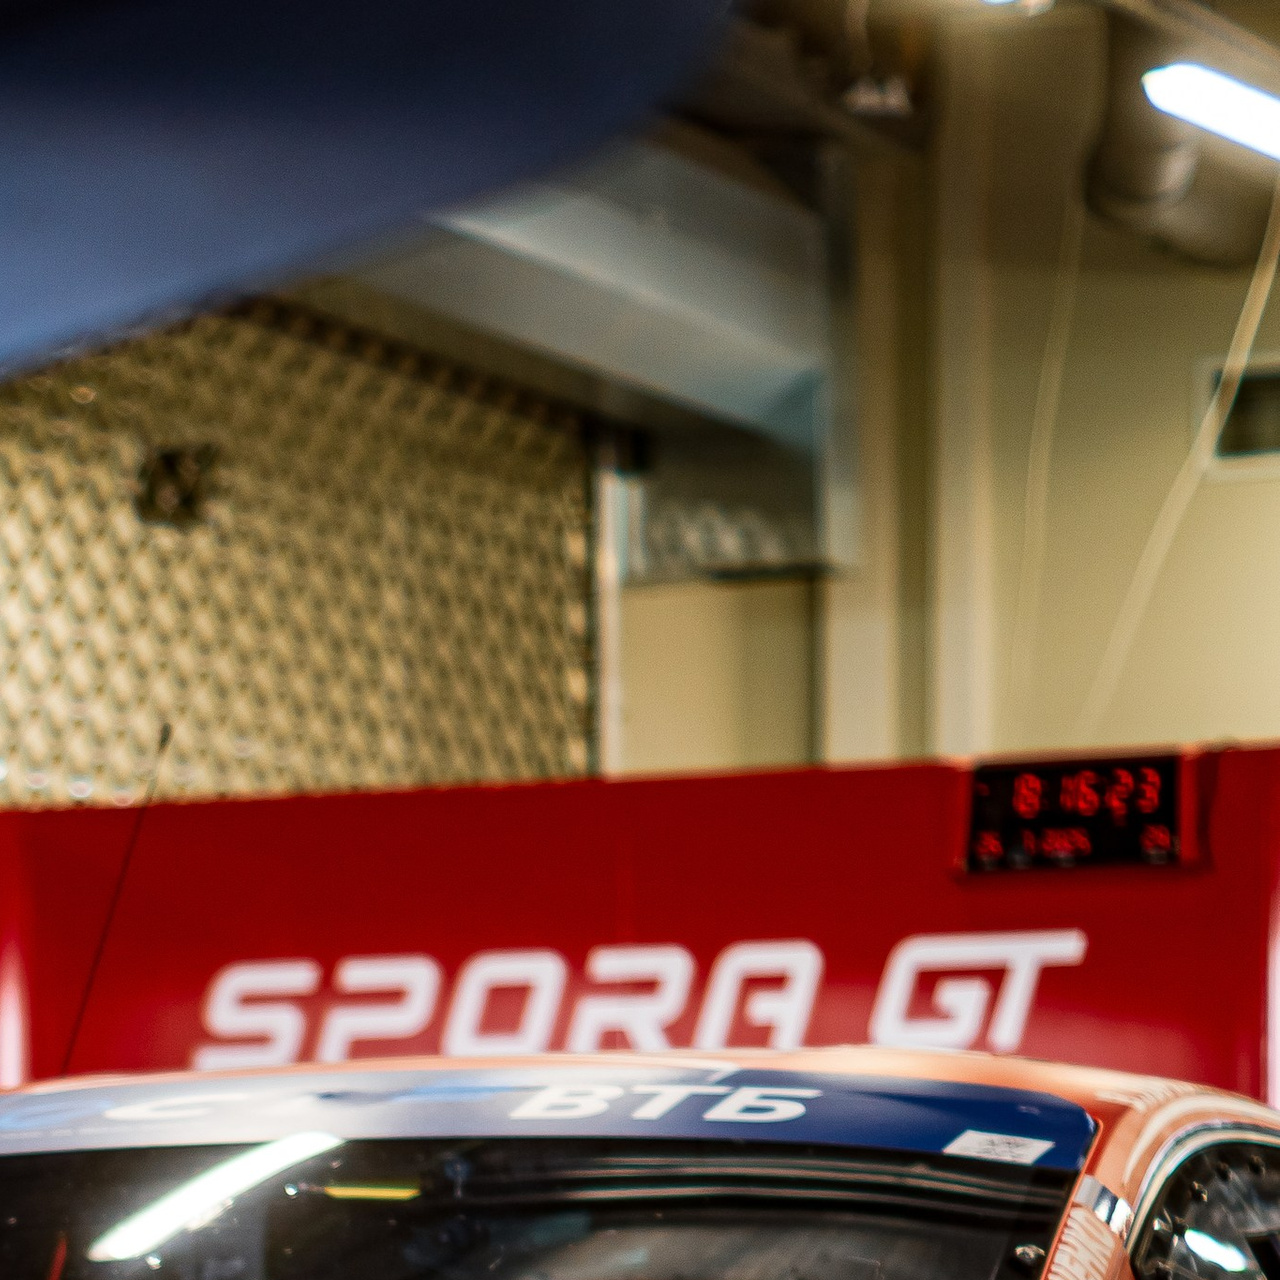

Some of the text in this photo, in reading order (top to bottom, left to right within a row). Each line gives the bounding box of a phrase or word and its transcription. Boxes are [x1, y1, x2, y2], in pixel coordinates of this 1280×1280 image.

[190, 928, 1086, 1070] SPORA GT
[508, 1084, 823, 1124] ВТБ
